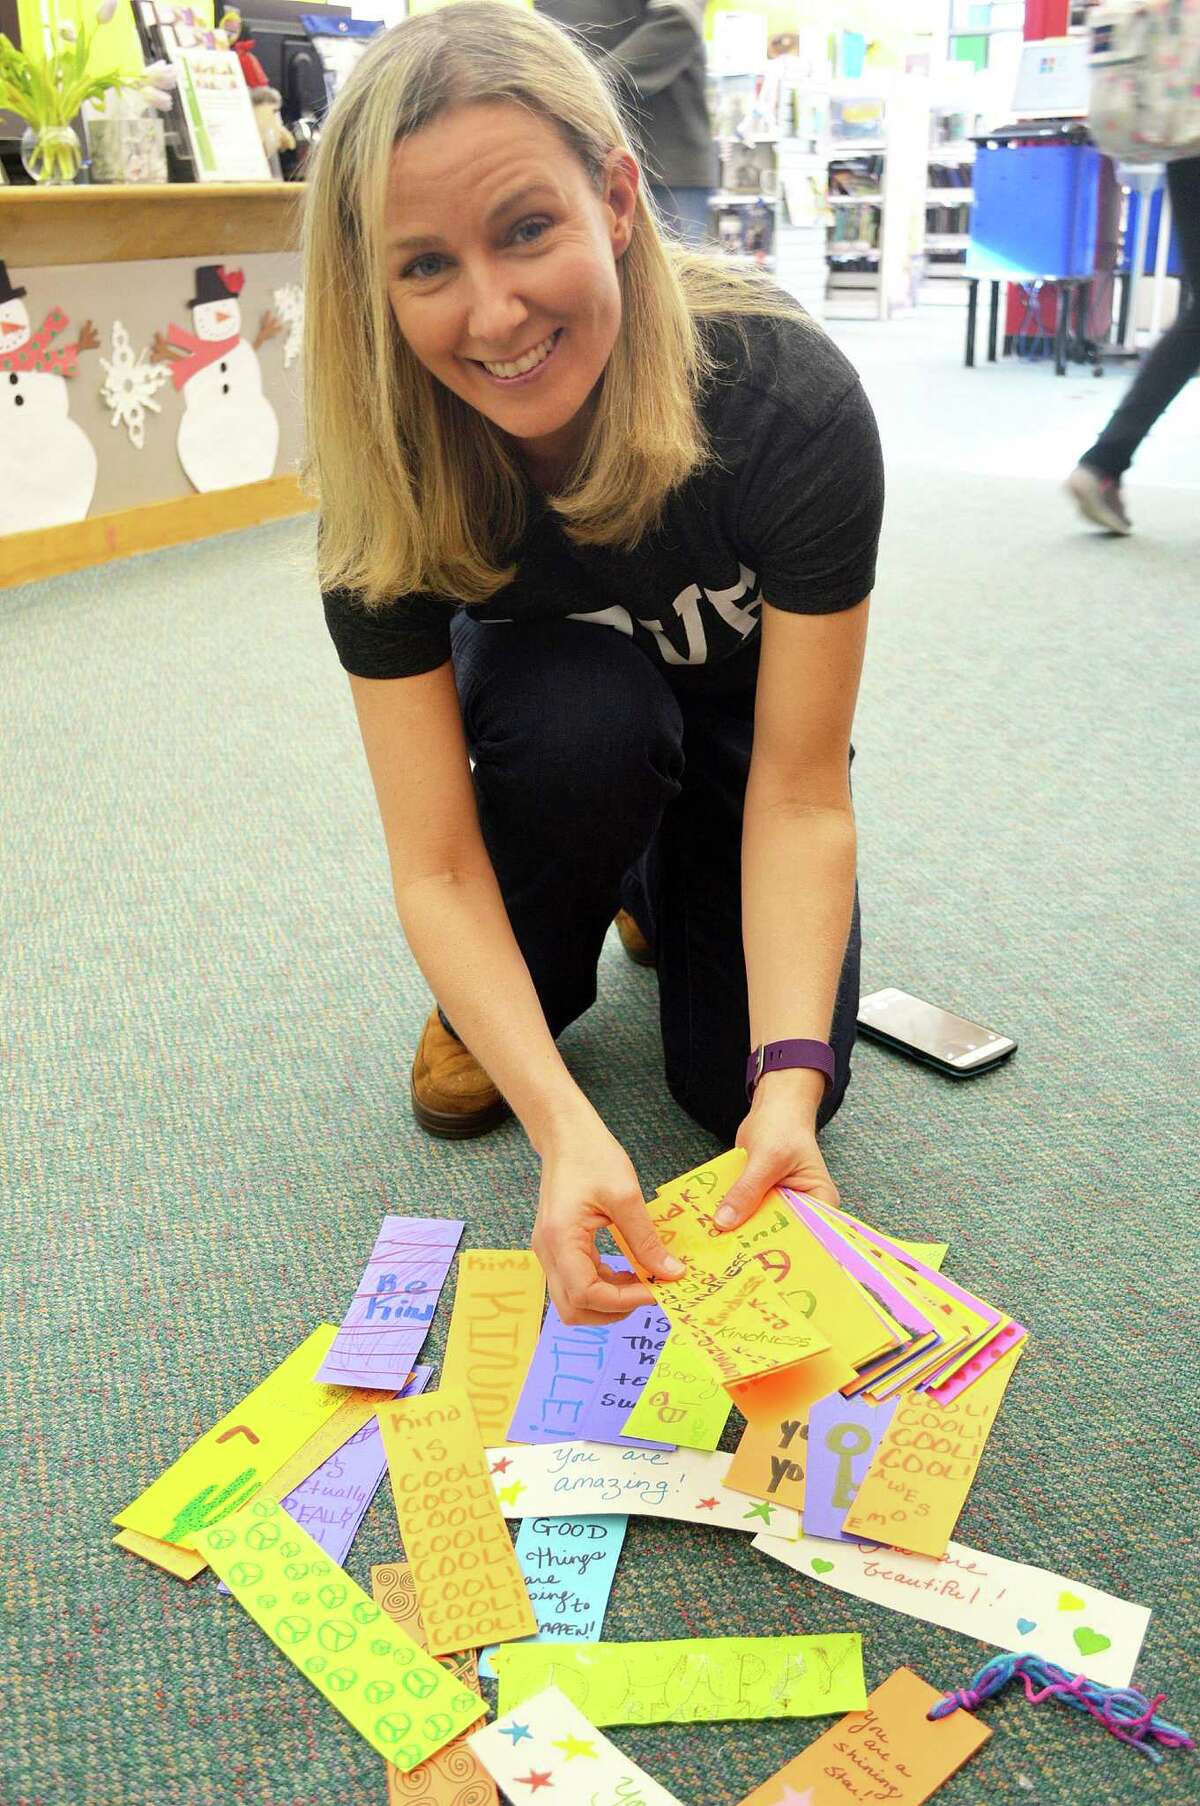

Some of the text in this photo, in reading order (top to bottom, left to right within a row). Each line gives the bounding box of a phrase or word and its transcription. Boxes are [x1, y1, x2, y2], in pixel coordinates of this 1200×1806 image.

[376, 1274, 429, 1296] Be
[622, 1450, 669, 1466] are
[553, 1473, 686, 1505] amazing!
[532, 1517, 608, 1540] GOOD
[528, 1586, 591, 1614] oing to
